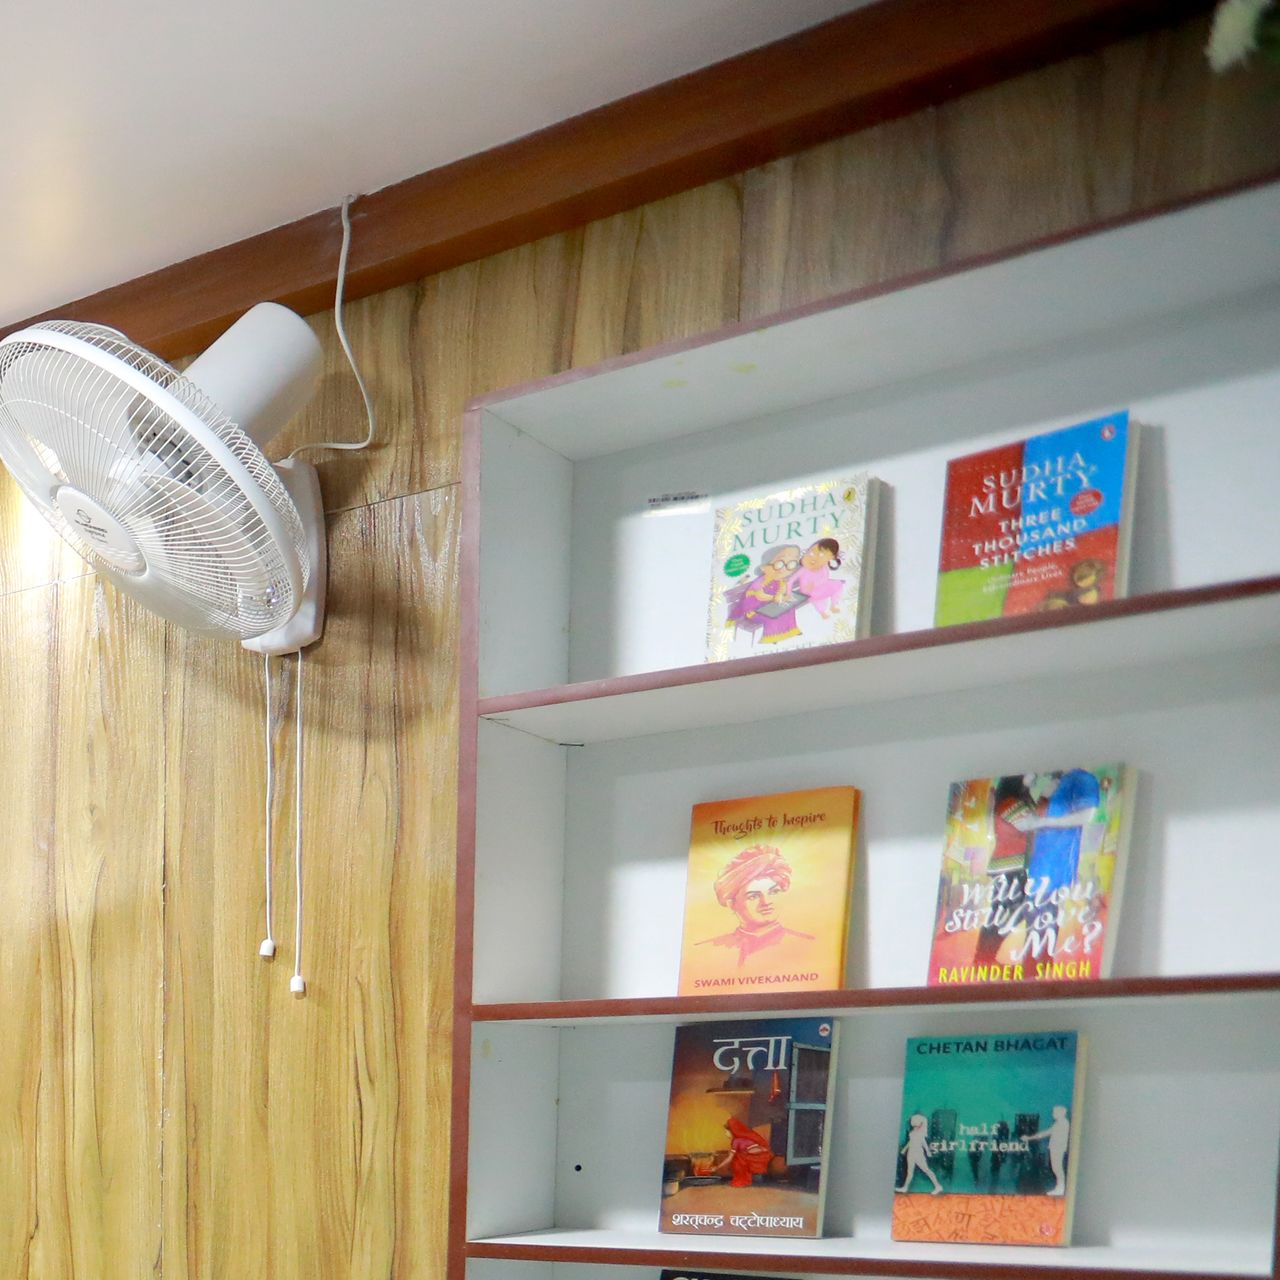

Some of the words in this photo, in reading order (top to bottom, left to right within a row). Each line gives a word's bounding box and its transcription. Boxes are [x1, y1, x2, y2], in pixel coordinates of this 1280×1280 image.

[983, 452, 1086, 493] SUDHA
[968, 470, 1090, 518] MURTY
[742, 493, 837, 527] SUDHA
[999, 508, 1061, 533] THREE
[733, 509, 846, 551] MURTY
[972, 519, 1087, 556] THOUSAND
[979, 538, 1077, 570] STITCHES
[711, 816, 763, 840] Thoughts
[765, 814, 778, 828] to
[783, 812, 826, 827] Inspire
[694, 978, 735, 988] SWAMI
[739, 972, 819, 985] VIVEKANAND
[939, 964, 1024, 984] RAVINDER
[1035, 960, 1090, 979] SINGH
[713, 1036, 792, 1074] दत्ता
[917, 1041, 988, 1055] CHETAN
[994, 1037, 1068, 1051] BHAGAT
[959, 1123, 1001, 1136] half
[929, 1139, 1030, 1154] girlfriend
